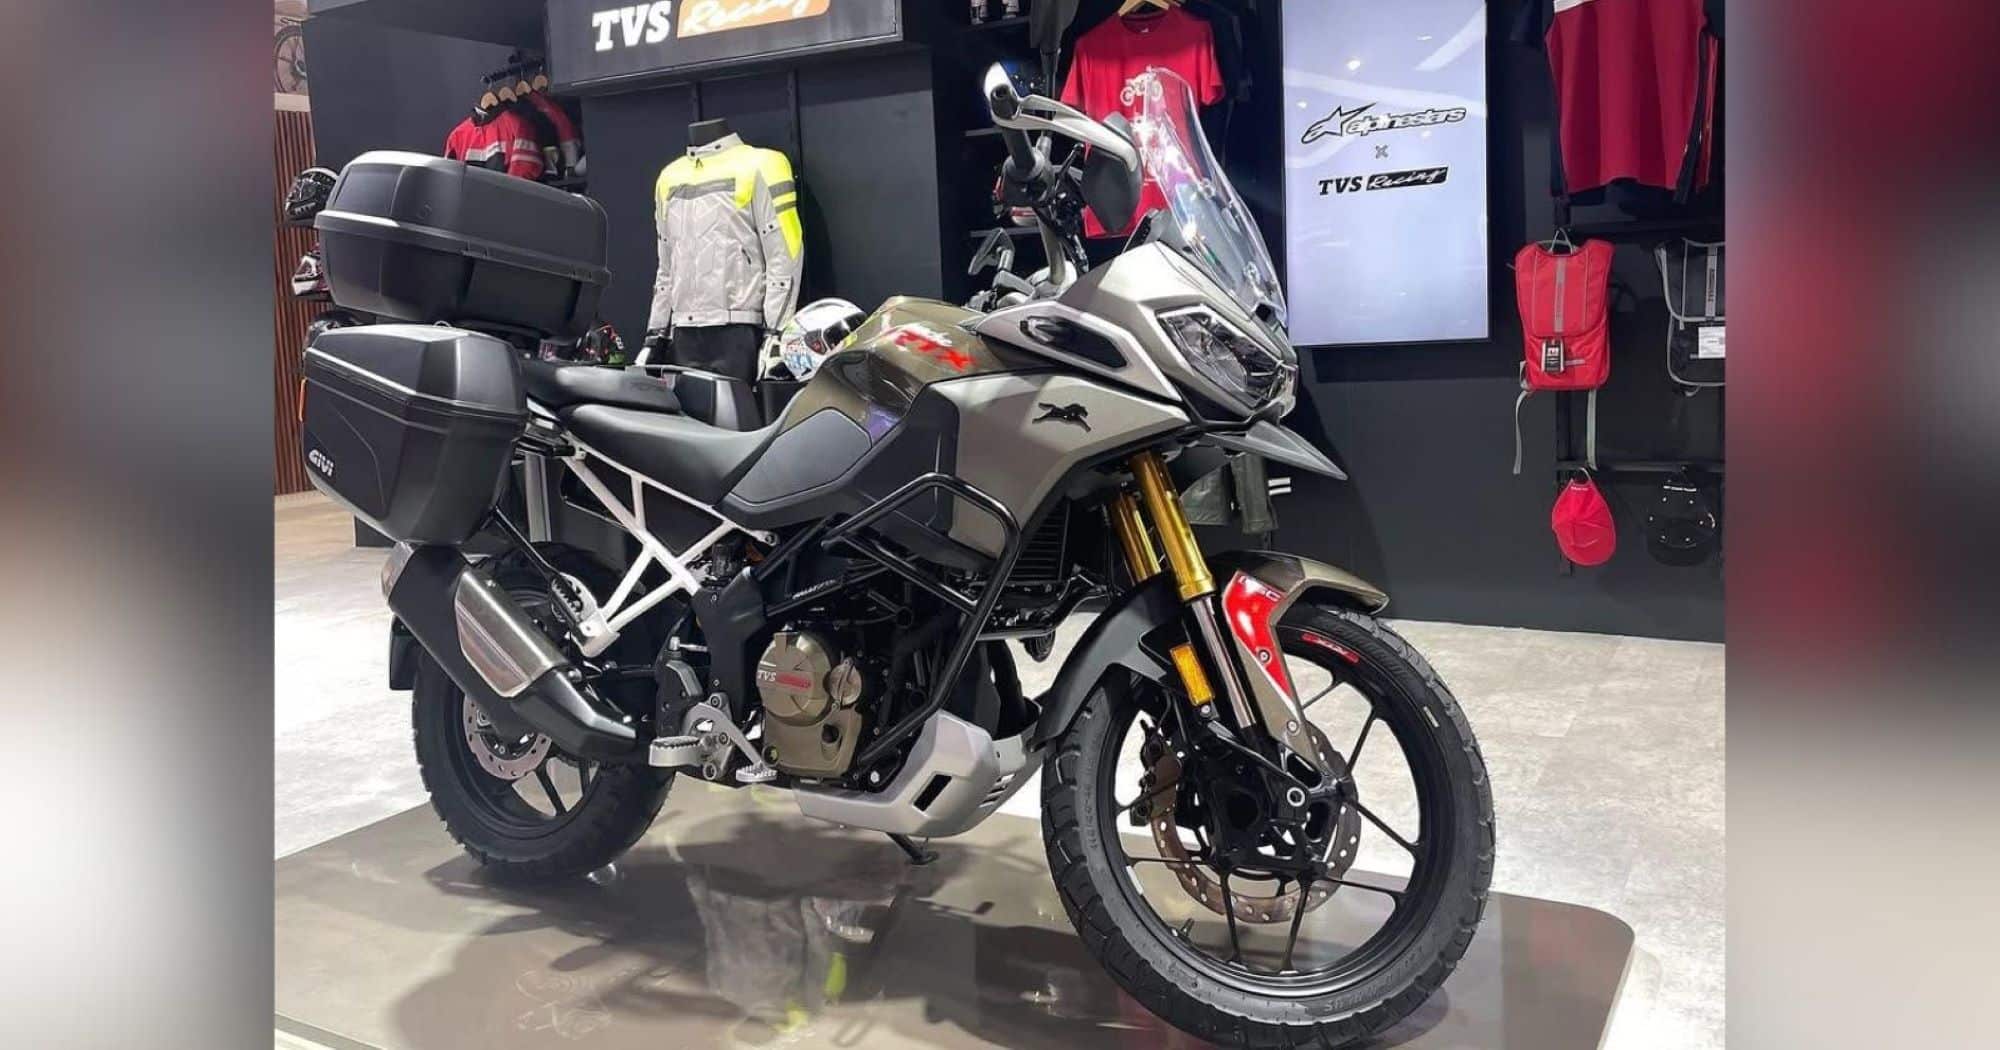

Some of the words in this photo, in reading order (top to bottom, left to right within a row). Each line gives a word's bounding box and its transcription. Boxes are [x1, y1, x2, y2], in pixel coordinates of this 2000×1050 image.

[591, 0, 671, 51] TVS
[1346, 108, 1467, 136] alpinestars
[1319, 176, 1363, 195] TVS
[1368, 169, 1447, 190] Racing
[308, 449, 334, 477] GIVI
[757, 669, 777, 682] TVS
